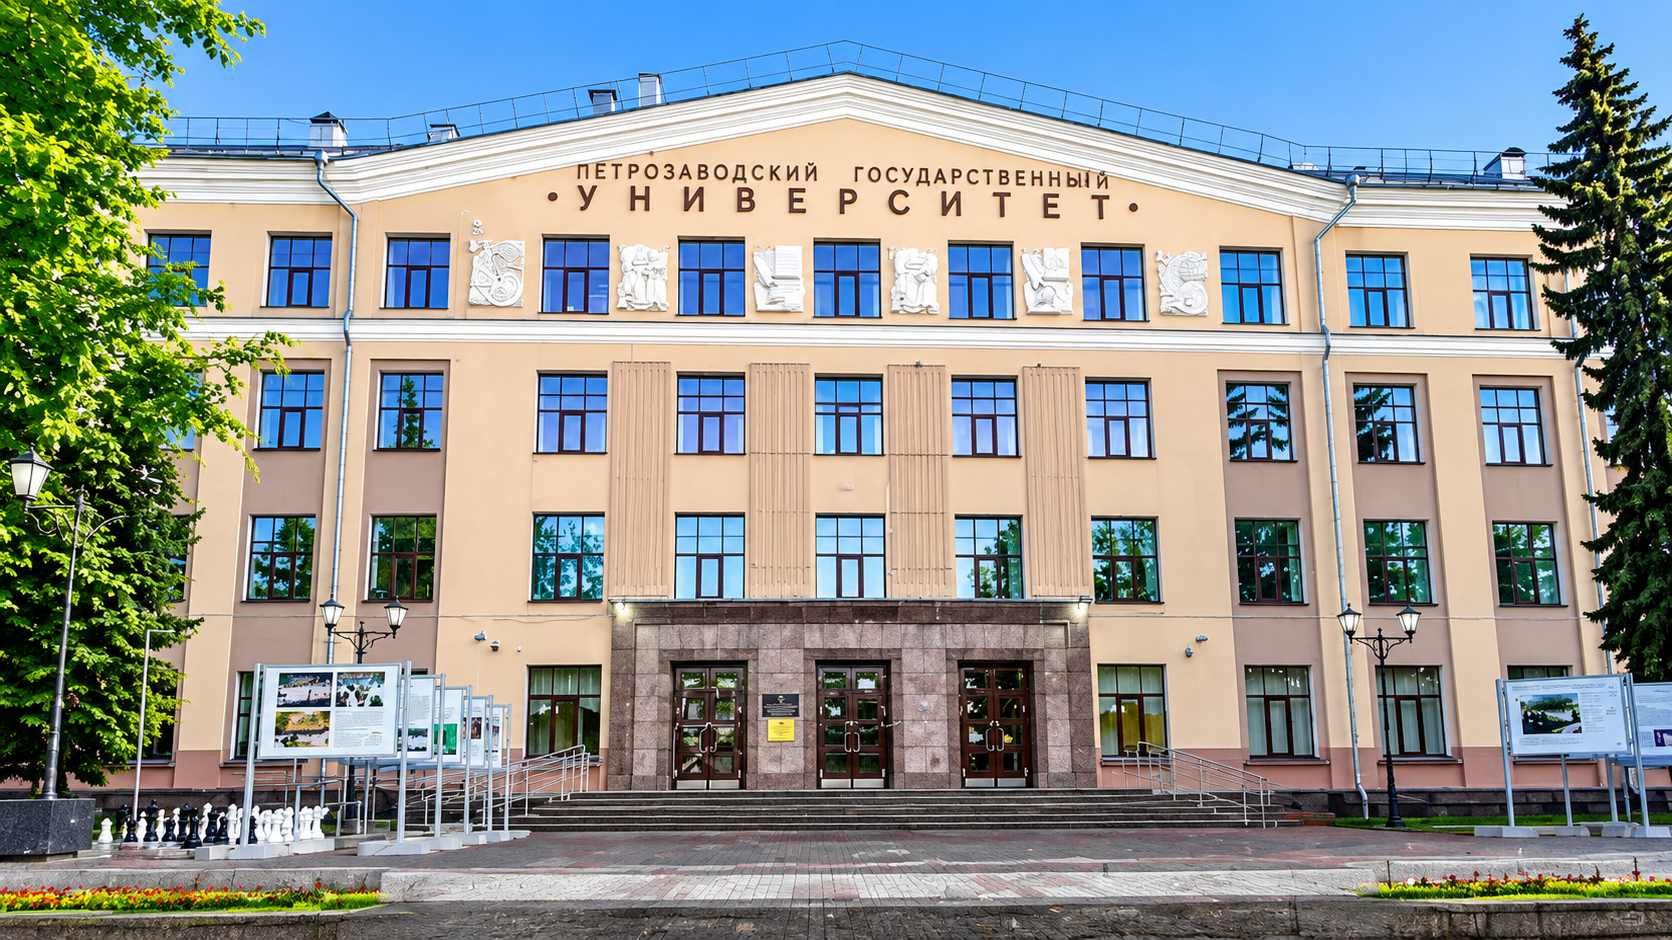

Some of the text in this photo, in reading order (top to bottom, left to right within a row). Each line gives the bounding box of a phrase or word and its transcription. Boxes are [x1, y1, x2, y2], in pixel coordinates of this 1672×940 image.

[577, 162, 1109, 189] ПЕТРОЗАВОДСКИЙ ГОСУДАРСТВЕННЫЙ
[577, 185, 1110, 220] УНИВЕРСИТЕТ
